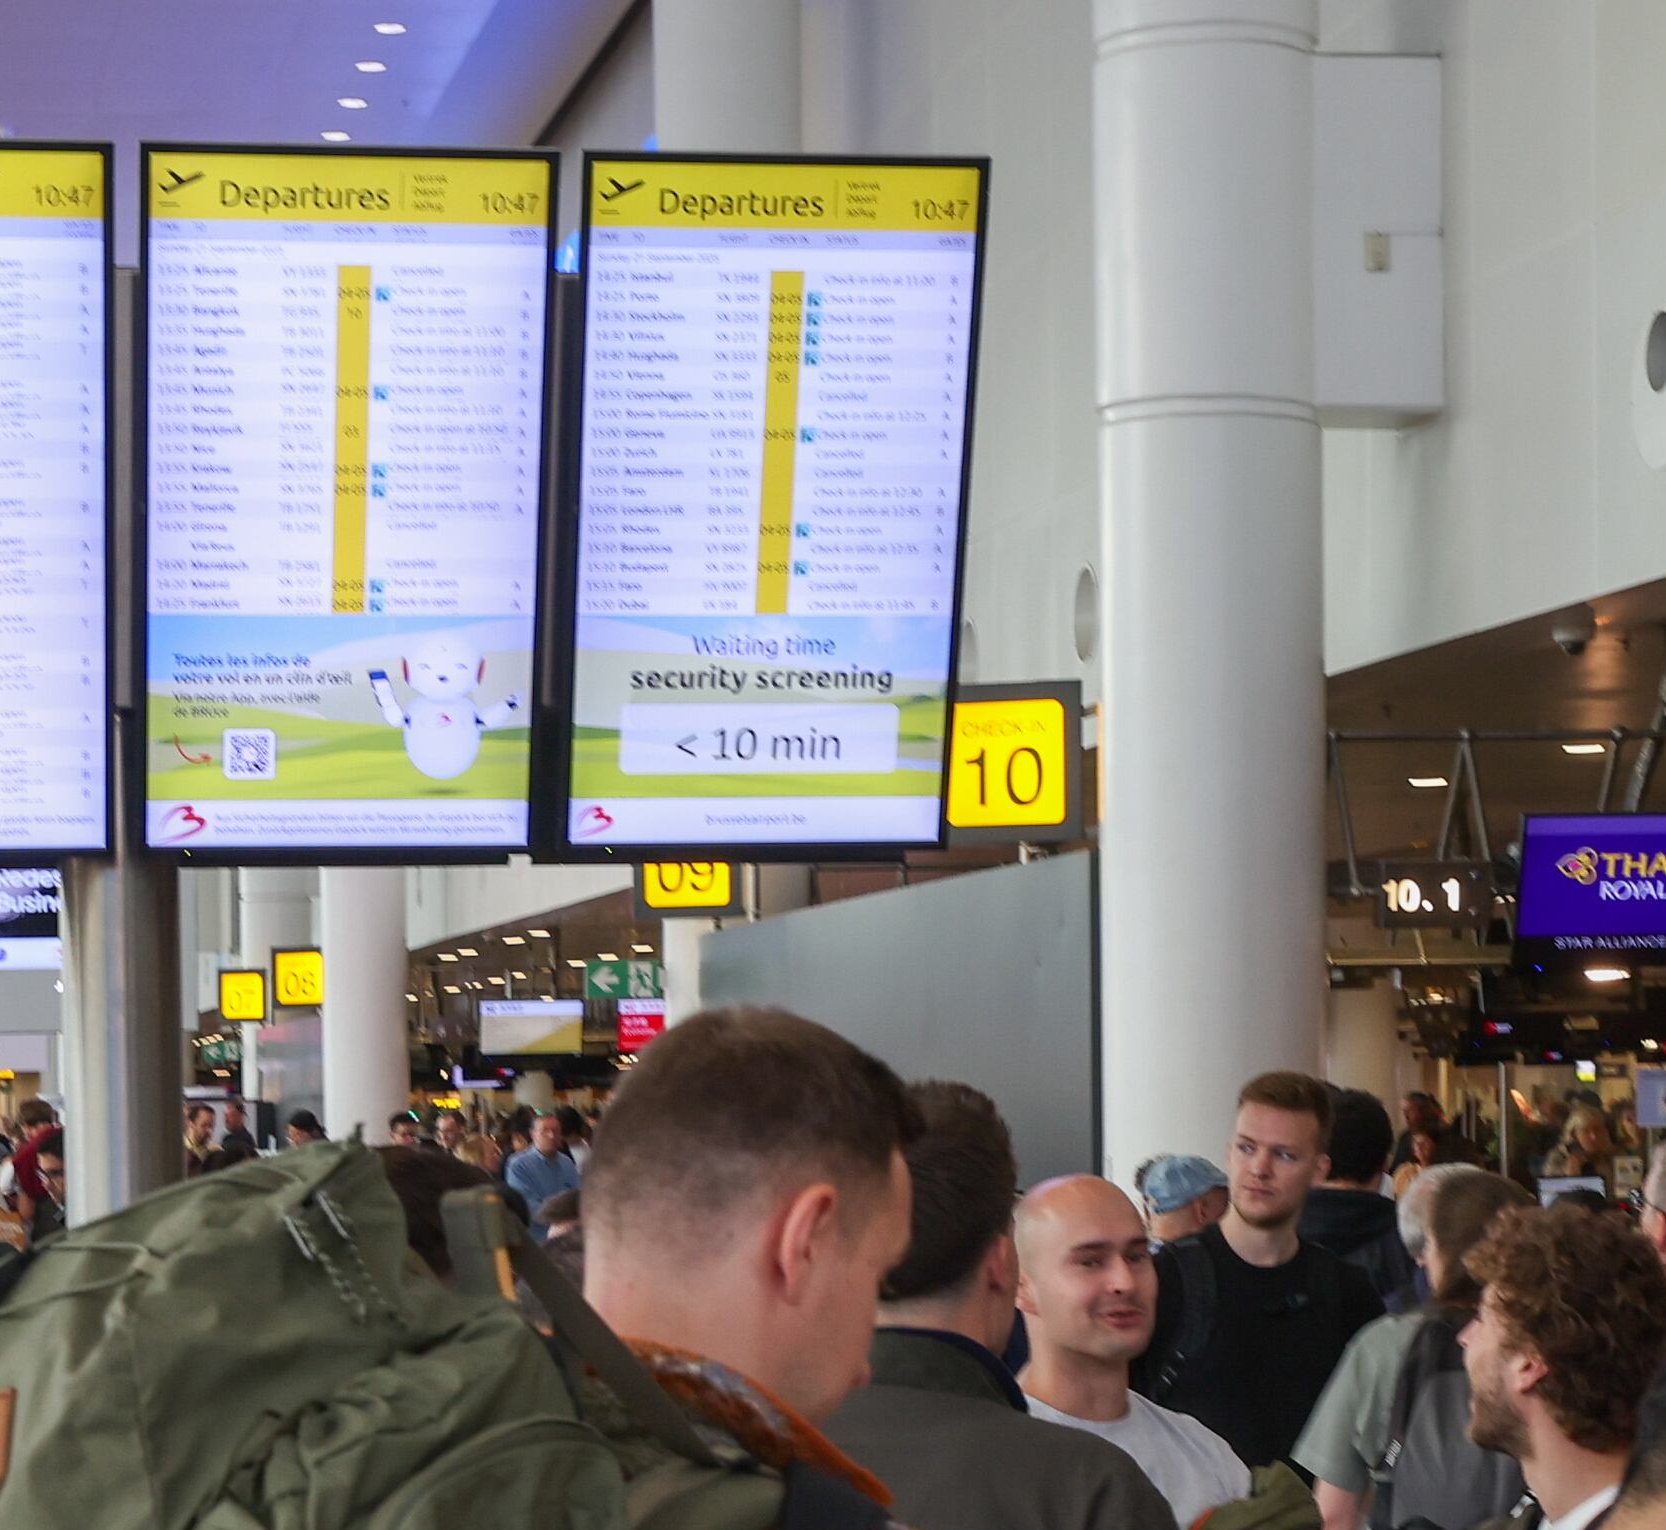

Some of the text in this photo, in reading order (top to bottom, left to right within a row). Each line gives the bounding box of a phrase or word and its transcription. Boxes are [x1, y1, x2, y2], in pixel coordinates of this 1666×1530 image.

[32, 184, 94, 208] 10:47
[219, 179, 390, 213] Departures
[479, 192, 539, 214] 10:47
[659, 187, 824, 220] Departures
[912, 199, 970, 222] 10:47
[692, 635, 836, 659] Waiting time
[630, 666, 893, 695] security screening
[712, 728, 758, 761] 10
[771, 727, 841, 760] min
[965, 746, 1043, 806] 10
[657, 861, 715, 894] 09
[1554, 934, 1594, 951] STAR
[285, 970, 317, 998] 08
